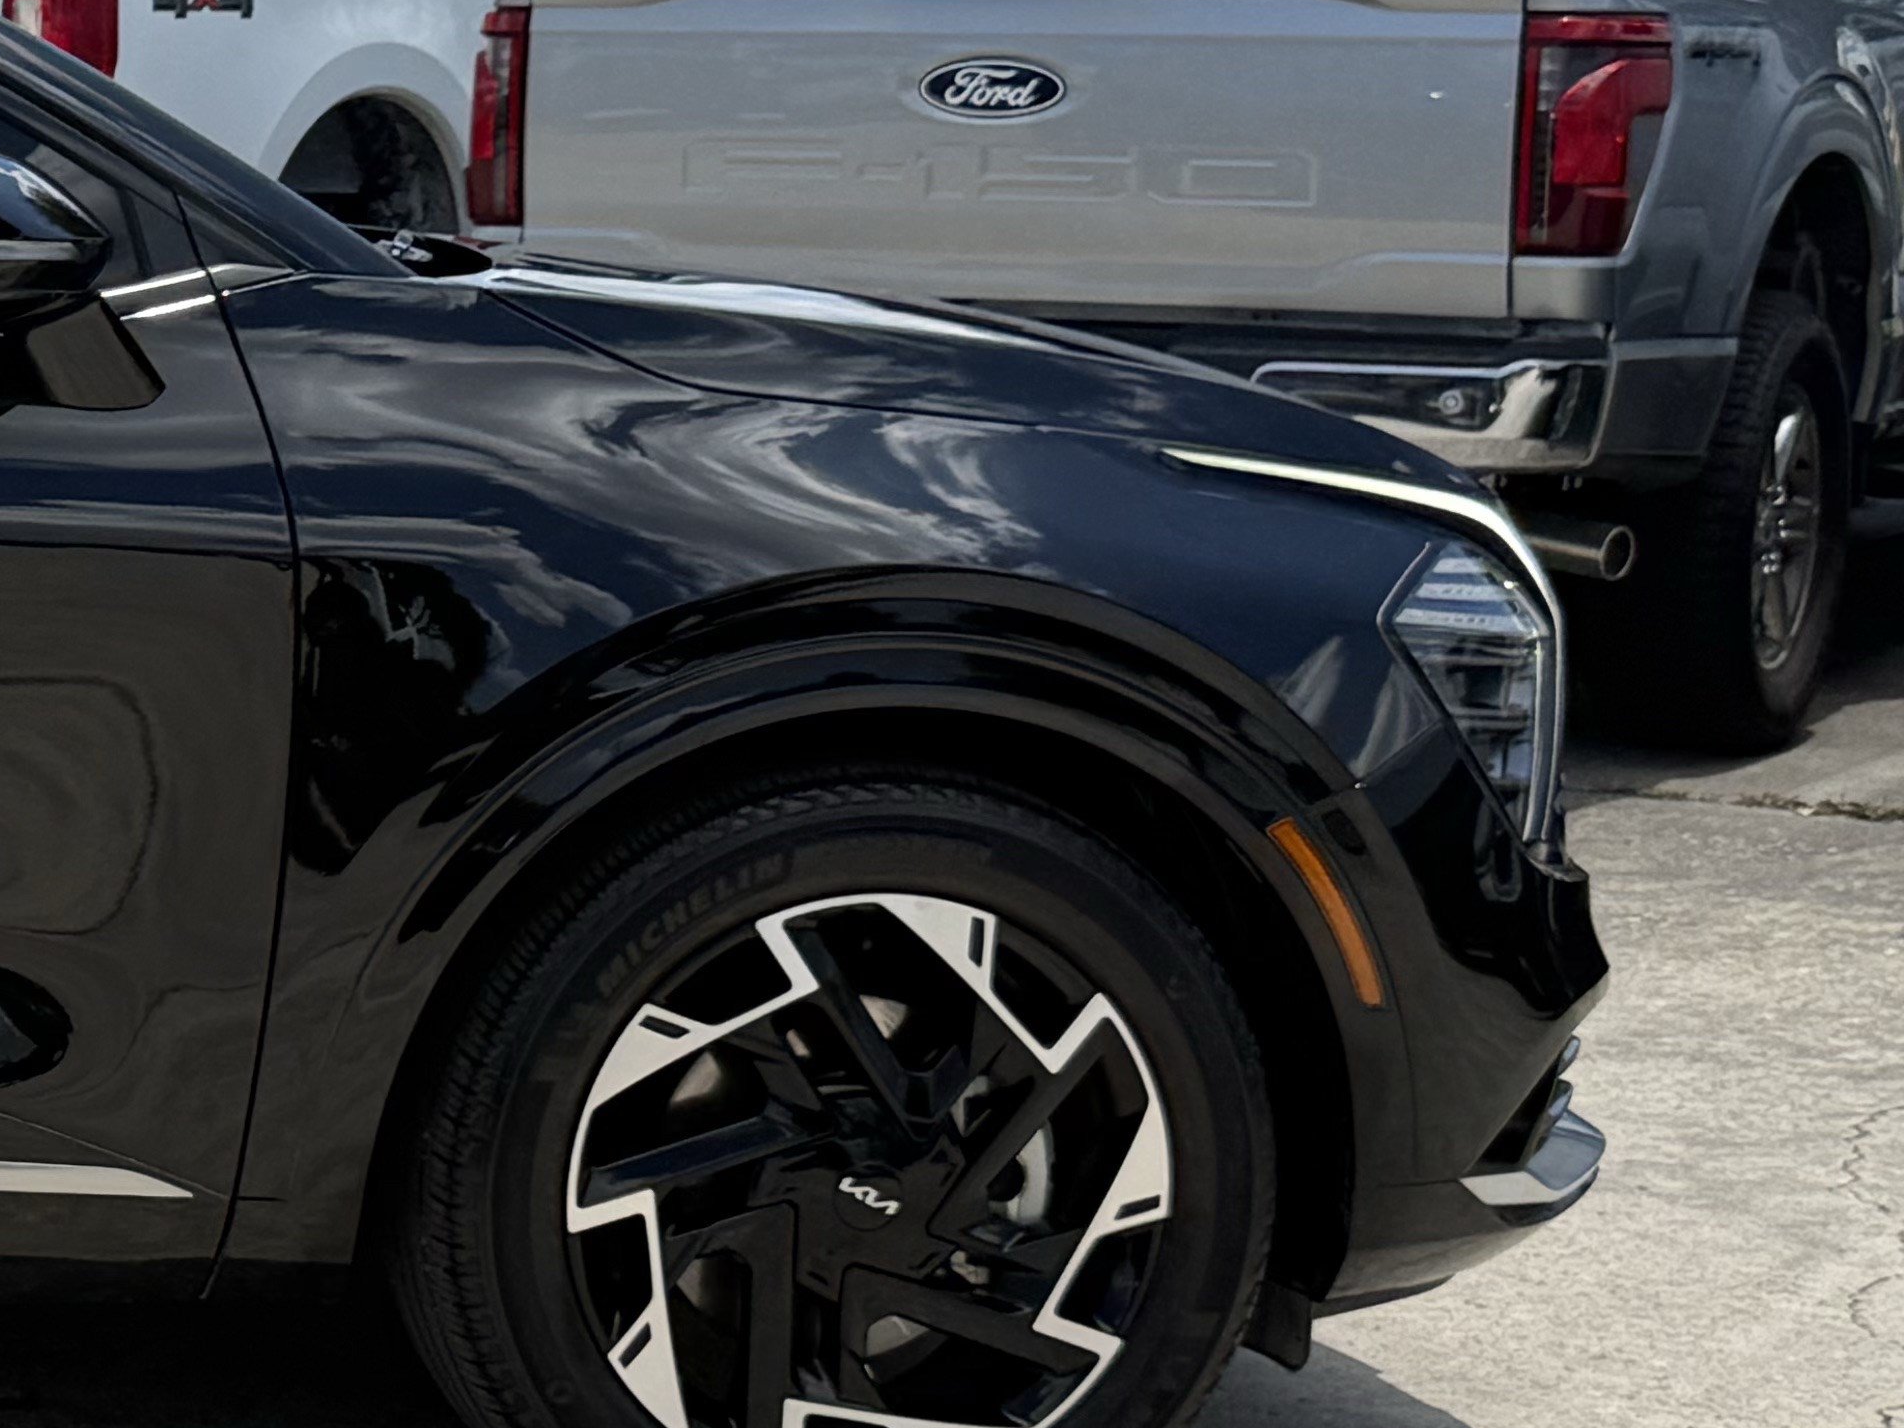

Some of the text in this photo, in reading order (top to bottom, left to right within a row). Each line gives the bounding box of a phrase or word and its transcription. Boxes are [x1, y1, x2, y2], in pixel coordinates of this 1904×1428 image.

[942, 67, 1043, 112] Ford
[684, 137, 1319, 207] F-150
[601, 857, 784, 994] MICHELIN
[838, 1176, 901, 1215] KIA
